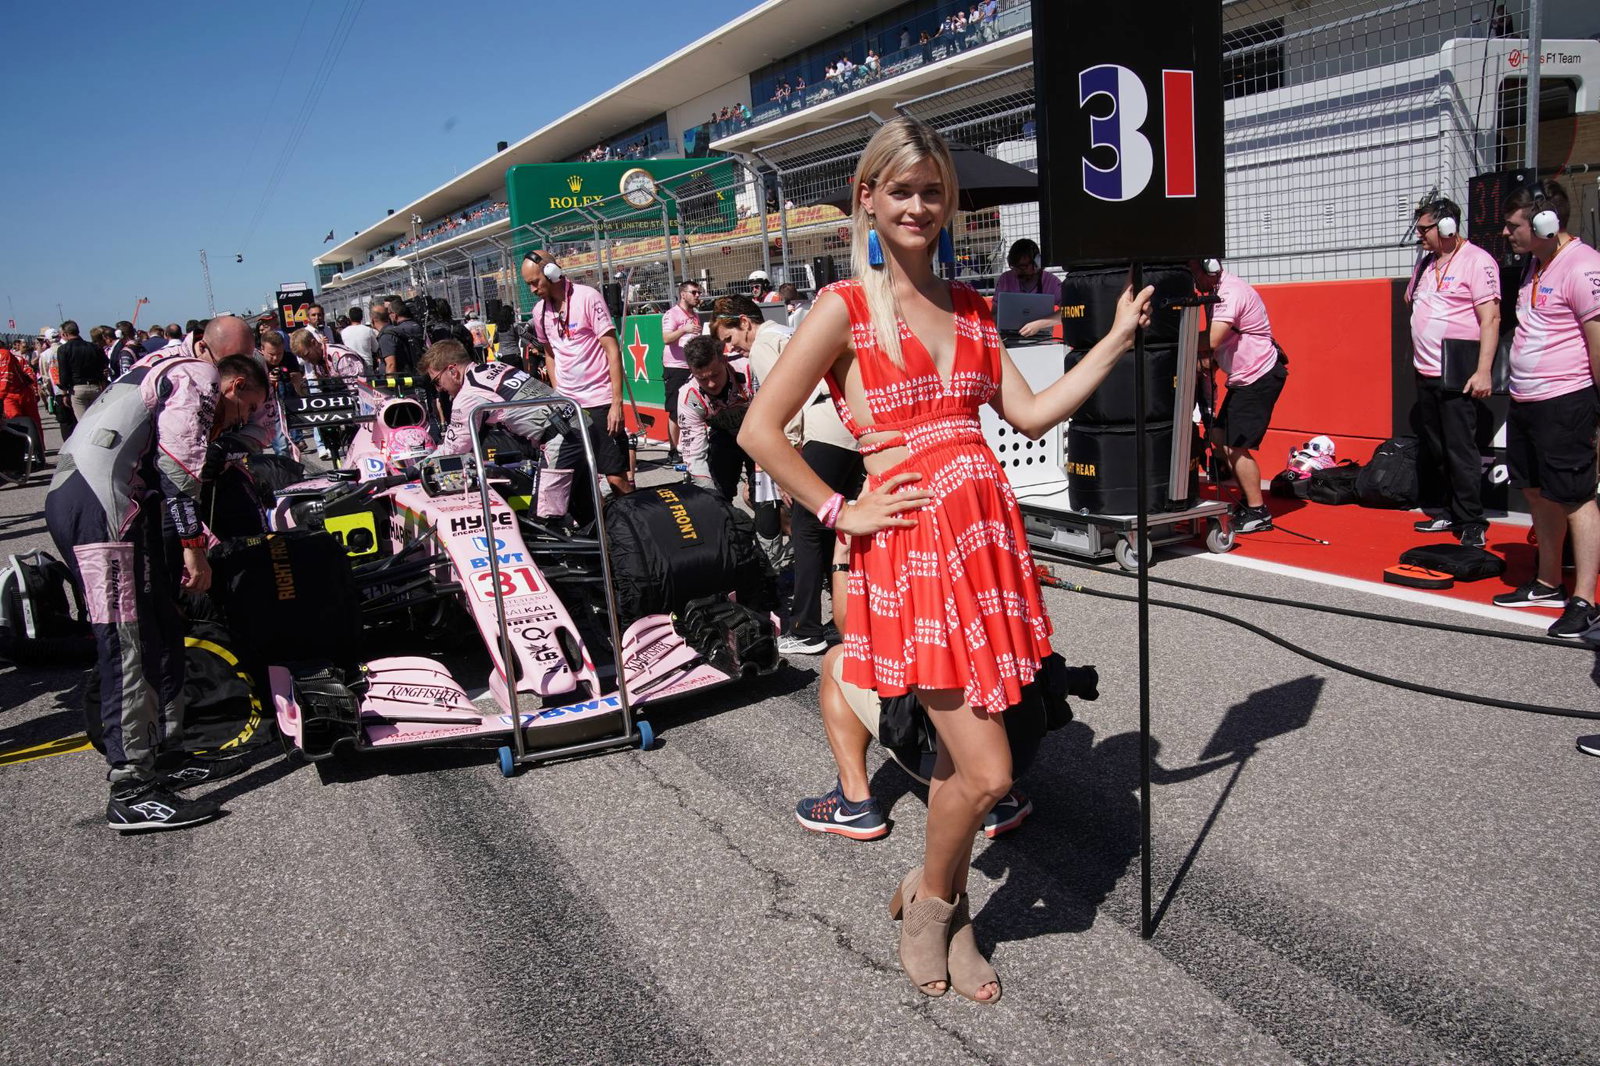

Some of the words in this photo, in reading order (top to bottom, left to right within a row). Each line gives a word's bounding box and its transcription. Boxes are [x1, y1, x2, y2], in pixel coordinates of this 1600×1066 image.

[1522, 53, 1545, 64] Hs
[1546, 53, 1556, 64] F1
[1559, 53, 1582, 64] Team
[1078, 63, 1197, 202] 31
[550, 195, 605, 209] ROLEX
[1065, 305, 1085, 318] FRONT
[1076, 463, 1096, 477] REAR
[656, 488, 680, 503] LEFT
[450, 511, 513, 533] HYPE
[669, 504, 698, 540] FRONT
[470, 552, 524, 569] BWT
[272, 562, 296, 601] RIGHT
[477, 567, 540, 598] 31
[497, 612, 558, 627] IRELLI
[386, 685, 461, 705] KINGFISHER
[538, 696, 620, 720] BWT
